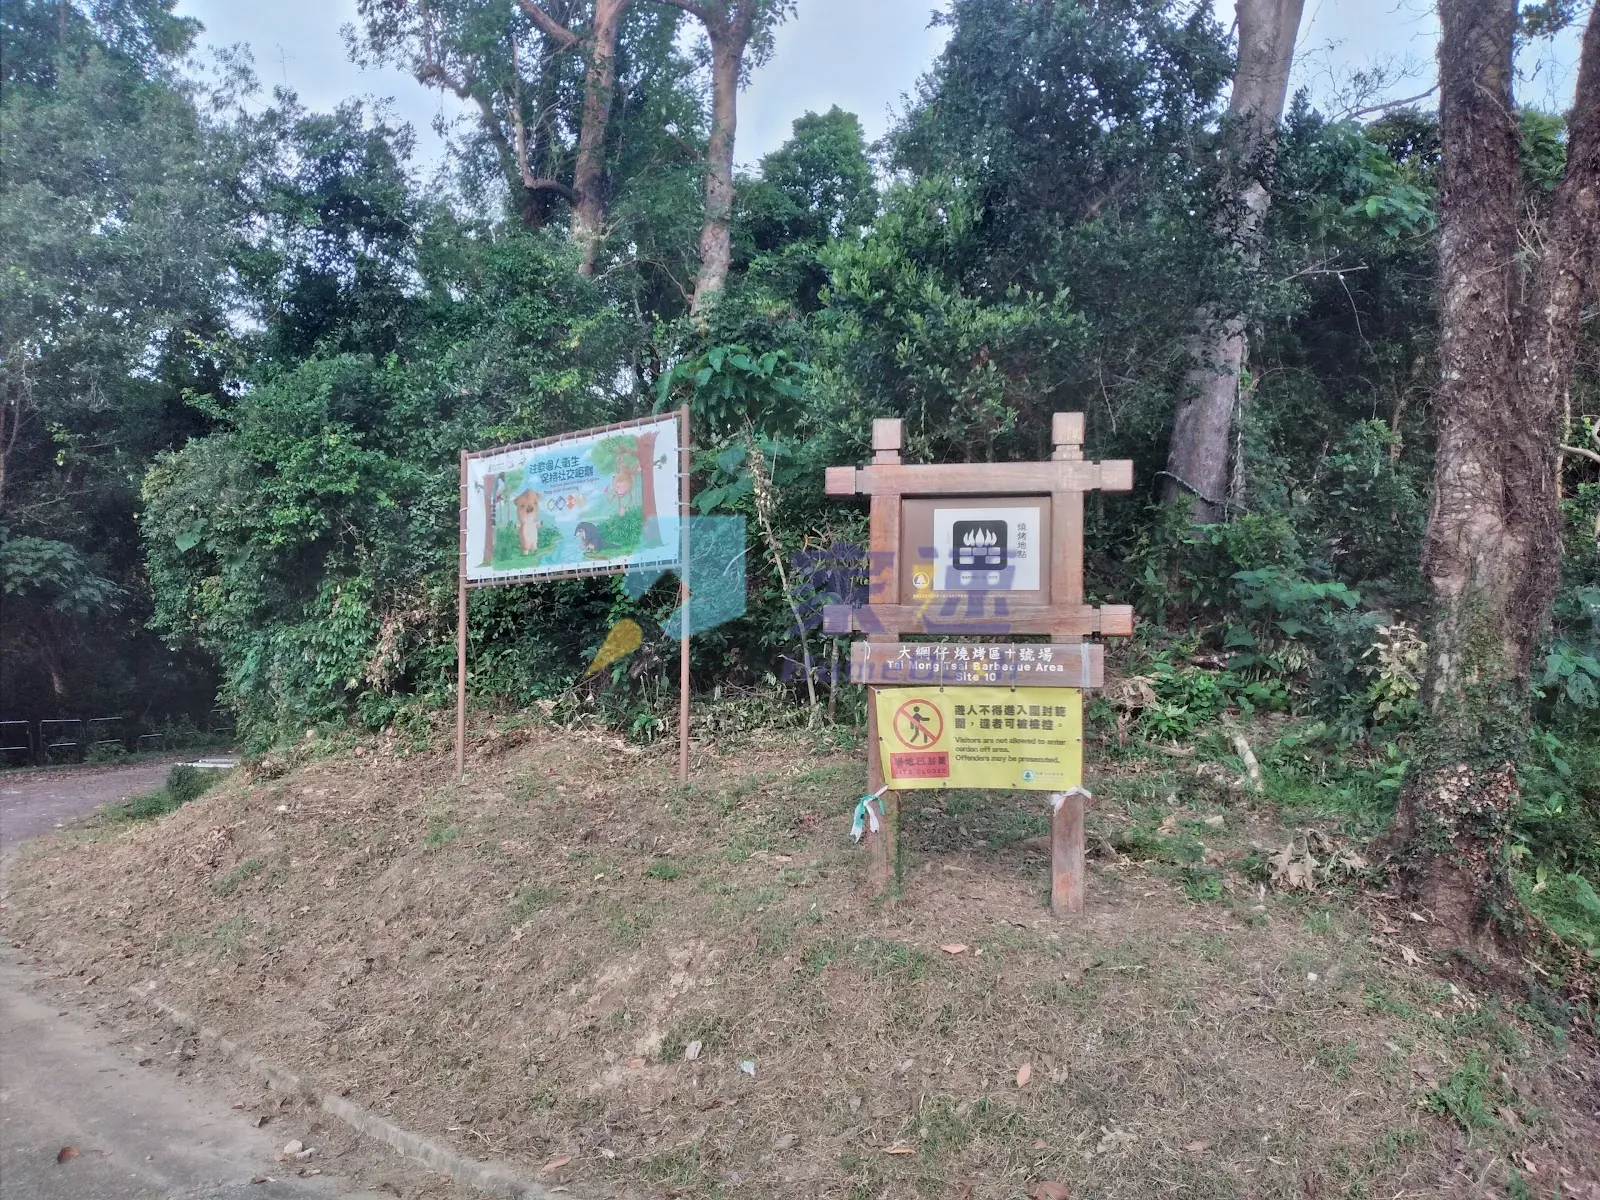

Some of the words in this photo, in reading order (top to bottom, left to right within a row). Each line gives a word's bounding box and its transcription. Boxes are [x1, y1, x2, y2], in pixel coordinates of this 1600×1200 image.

[540, 465, 594, 484] 保持社交距離
[1017, 522, 1027, 559] 燒烤地點
[897, 645, 1054, 662] 大網仔燒烤區十號場
[887, 660, 904, 670] Tai
[908, 661, 940, 672] Mong
[943, 661, 968, 671] Tsai
[1035, 662, 1064, 672] Area
[955, 672, 980, 682] Site
[985, 672, 997, 682] 10
[954, 736, 981, 744] Visitors
[1008, 737, 1036, 745] allowed
[955, 754, 990, 762] Offenders
[991, 756, 1007, 764] may
[1008, 755, 1017, 763] be
[1017, 756, 1061, 764] prosecuted.
